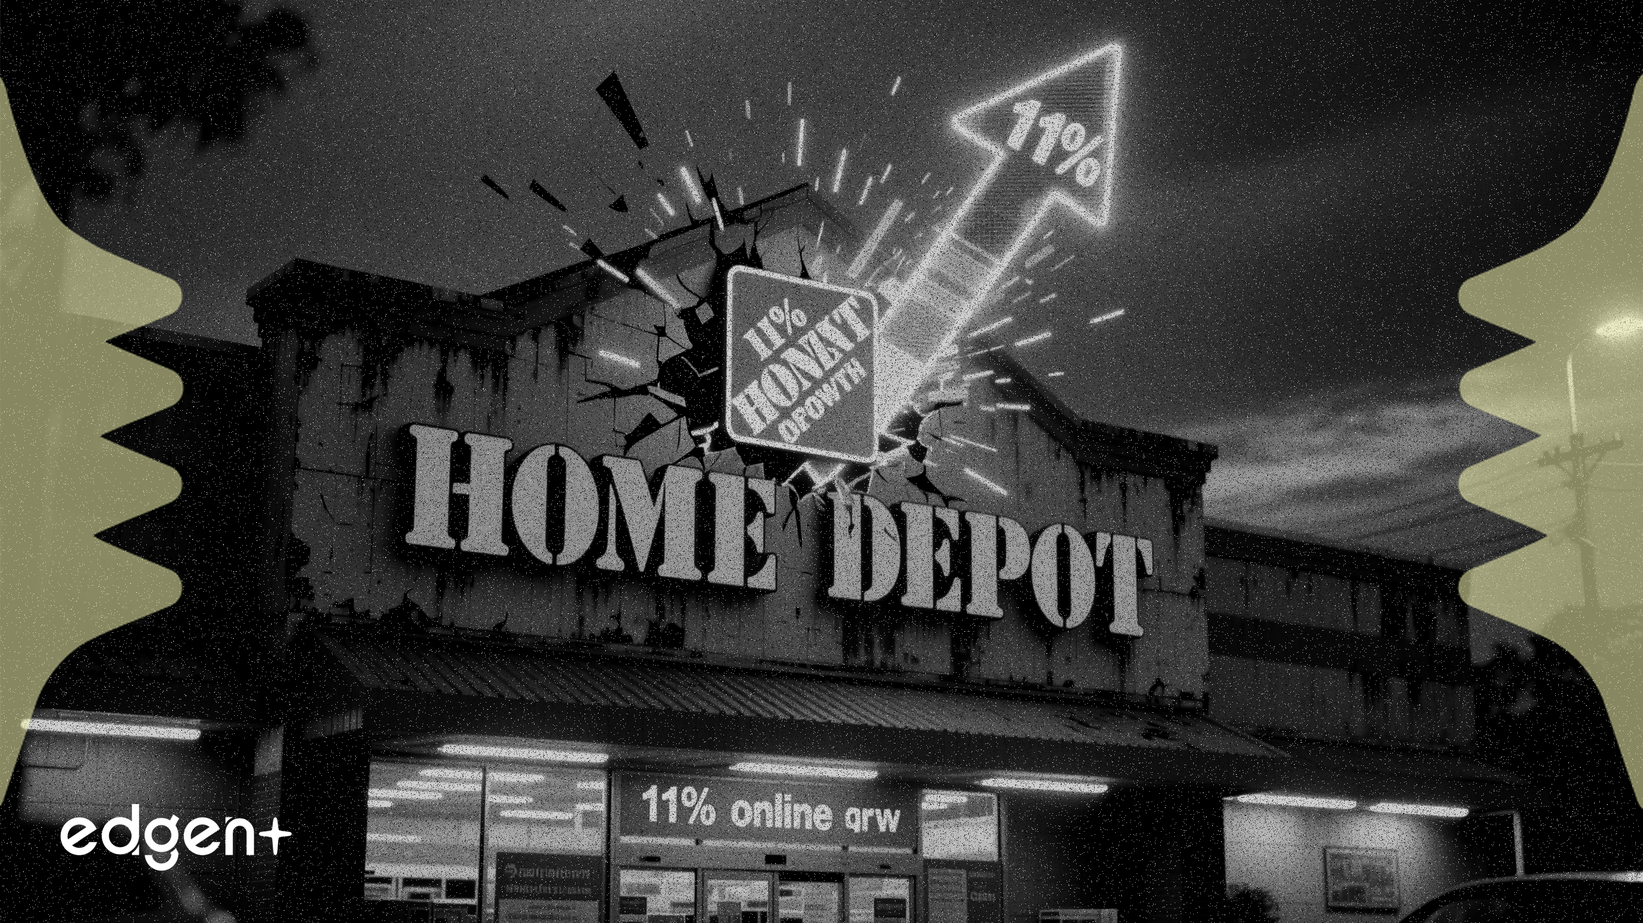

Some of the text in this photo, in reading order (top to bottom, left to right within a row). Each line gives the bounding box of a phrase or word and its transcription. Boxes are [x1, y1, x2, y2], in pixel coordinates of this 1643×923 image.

[1007, 99, 1101, 187] 11%
[743, 298, 807, 361] 11%
[405, 424, 1153, 637] HOME DEPOT
[642, 785, 716, 825] 11%
[730, 793, 833, 830] online
